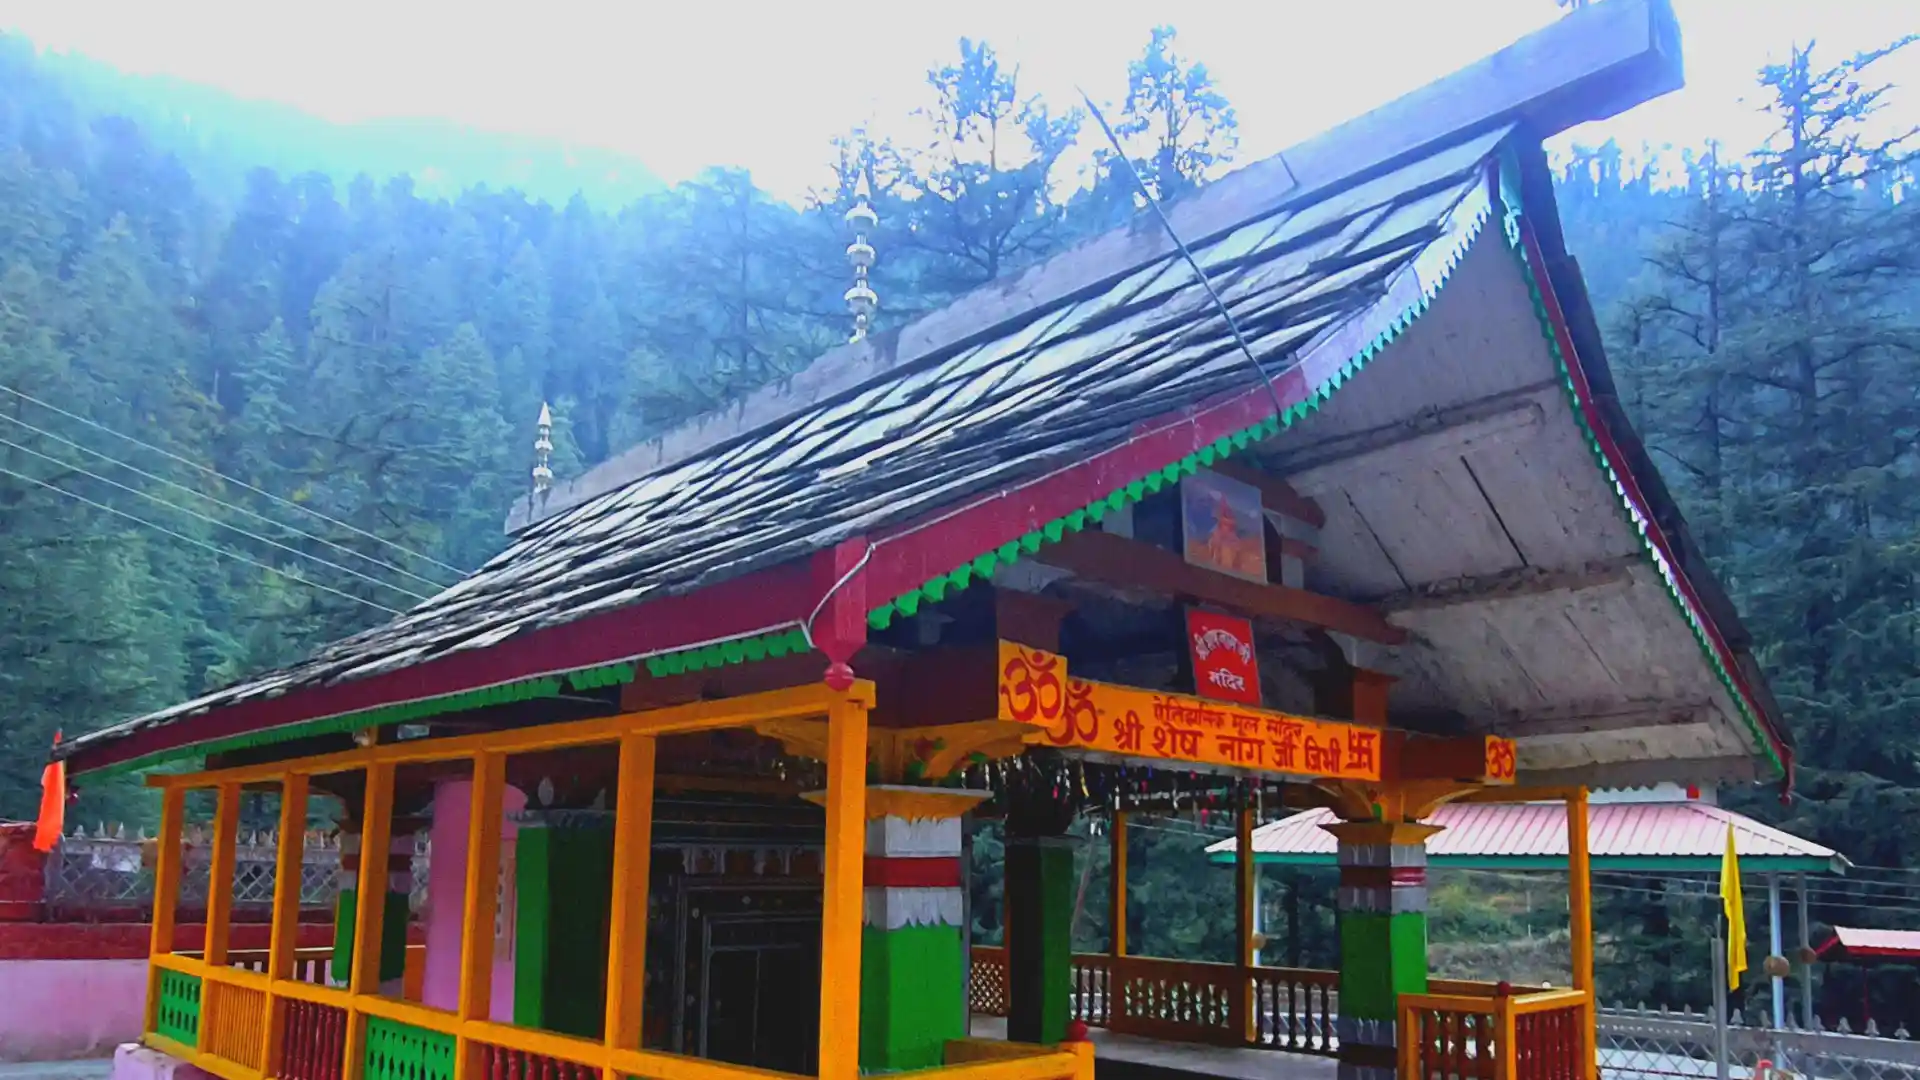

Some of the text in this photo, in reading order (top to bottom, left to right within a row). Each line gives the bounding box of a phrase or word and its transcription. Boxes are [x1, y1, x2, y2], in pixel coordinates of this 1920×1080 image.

[1208, 667, 1245, 692] मंदिर
[1231, 713, 1261, 737] मूल
[1113, 710, 1144, 751] श्री
[1151, 721, 1204, 758] शेष
[1215, 735, 1265, 765] नाग
[1270, 736, 1300, 768] जी
